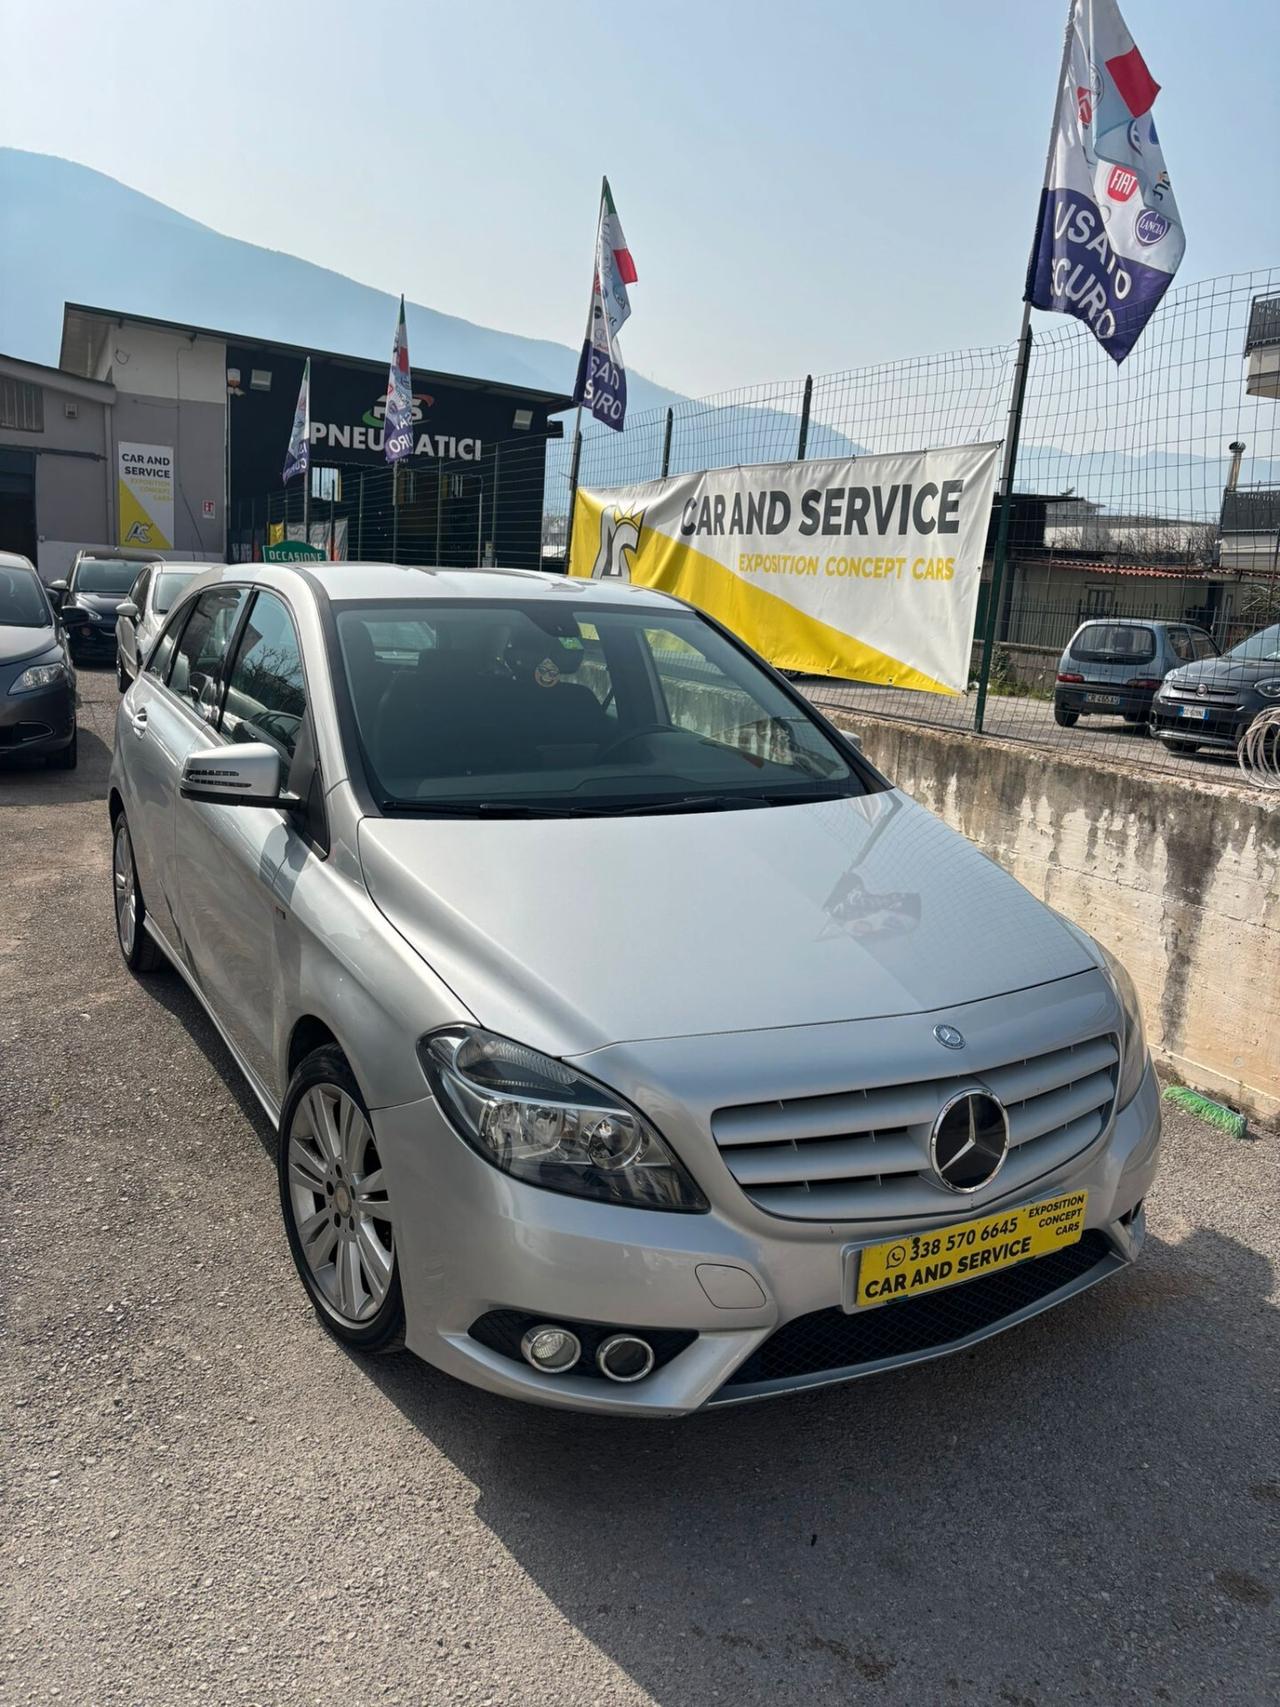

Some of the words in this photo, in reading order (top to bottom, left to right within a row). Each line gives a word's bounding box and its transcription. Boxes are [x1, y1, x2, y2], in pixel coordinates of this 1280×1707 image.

[1110, 169, 1137, 195] FIAT
[1139, 218, 1164, 235] LANCIA
[310, 421, 482, 461] PNEUATICI
[121, 453, 145, 464] CAR
[146, 456, 170, 466] AND
[124, 466, 171, 479] SERVICE
[680, 494, 726, 537] CAR
[729, 489, 792, 536] AND
[797, 479, 964, 537] SERVICE
[738, 553, 819, 577] EXPOSITION
[824, 556, 907, 579] CONCEPT
[911, 556, 956, 581] CARS
[1028, 1194, 1085, 1218] EXPOSITION
[1038, 1208, 1083, 1228] CONCEPT
[909, 1239, 941, 1262] 338
[946, 1229, 976, 1252] 570
[980, 1217, 1018, 1241] 6645
[1055, 1222, 1080, 1236] CARS
[864, 1274, 907, 1299] CAR
[910, 1261, 953, 1287] AND
[957, 1236, 1032, 1274] SERVICE
